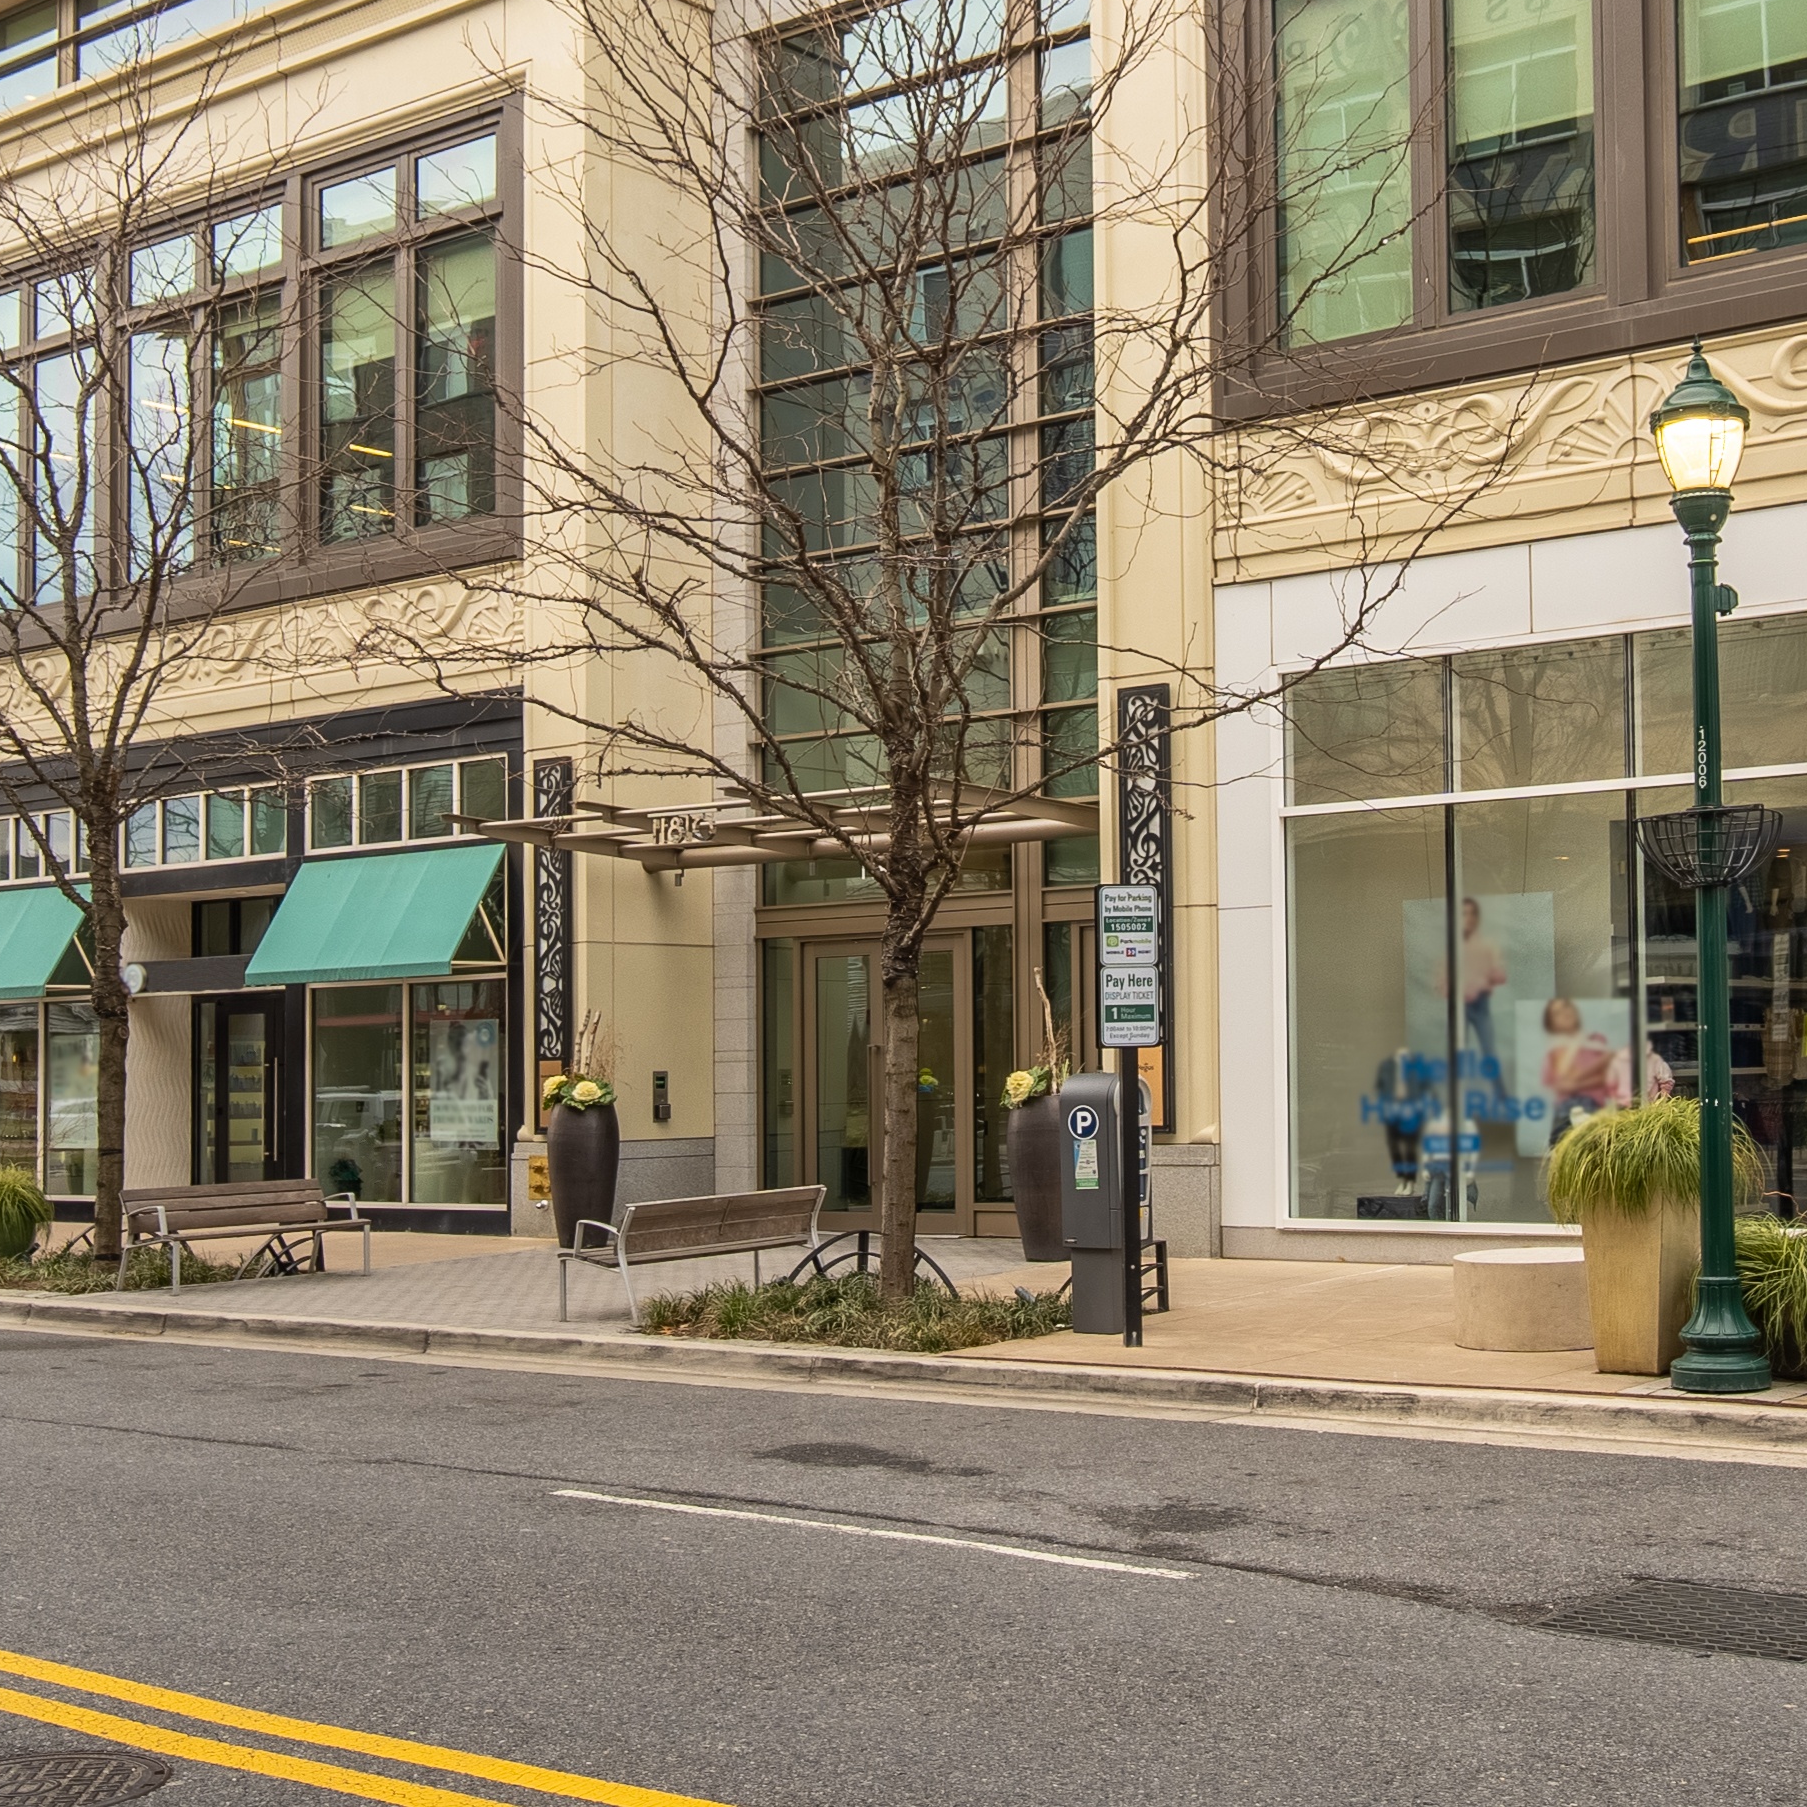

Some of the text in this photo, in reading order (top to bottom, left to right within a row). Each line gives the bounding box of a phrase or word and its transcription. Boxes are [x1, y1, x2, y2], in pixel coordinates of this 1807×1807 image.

[1105, 892, 1153, 903] Pay for Parking
[1105, 904, 1153, 914] by Mobile Phone
[1110, 923, 1147, 931] 1505002
[1105, 973, 1153, 990] Pay Here
[1104, 990, 1154, 1000] DISPLAY TICKET
[1111, 1007, 1118, 1020] 1
[1120, 1012, 1152, 1020] Maximum
[1130, 1031, 1151, 1040] Sunday
[1402, 1049, 1501, 1083] Hello
[1465, 1087, 1547, 1123] Rise
